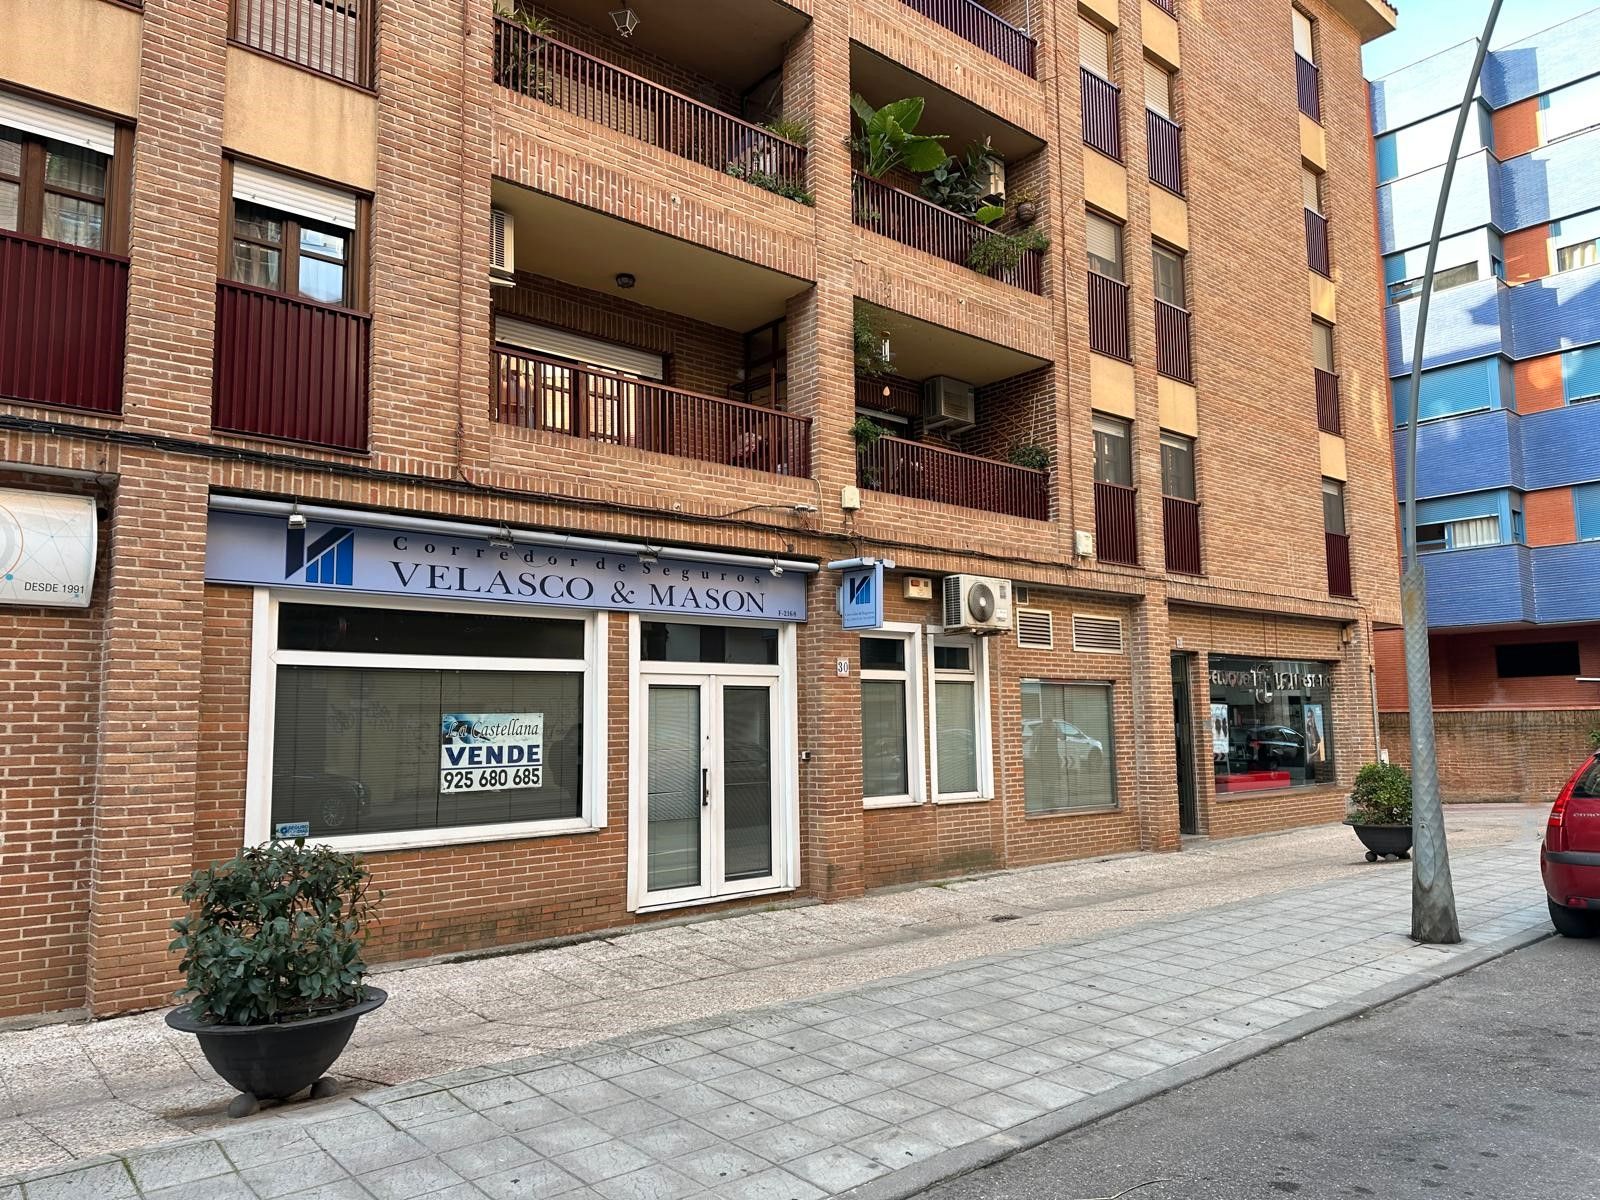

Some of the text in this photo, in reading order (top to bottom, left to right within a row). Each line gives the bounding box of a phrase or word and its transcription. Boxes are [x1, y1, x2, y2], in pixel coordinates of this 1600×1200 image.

[393, 536, 761, 584] Corredor de Seguros
[24, 581, 84, 594] DESDE 1991
[389, 561, 765, 614] VELASCO & MASON
[837, 661, 849, 673] 30
[446, 718, 539, 739] La Castellana
[445, 745, 540, 766] VENDE
[443, 768, 540, 790] 925 680 685
